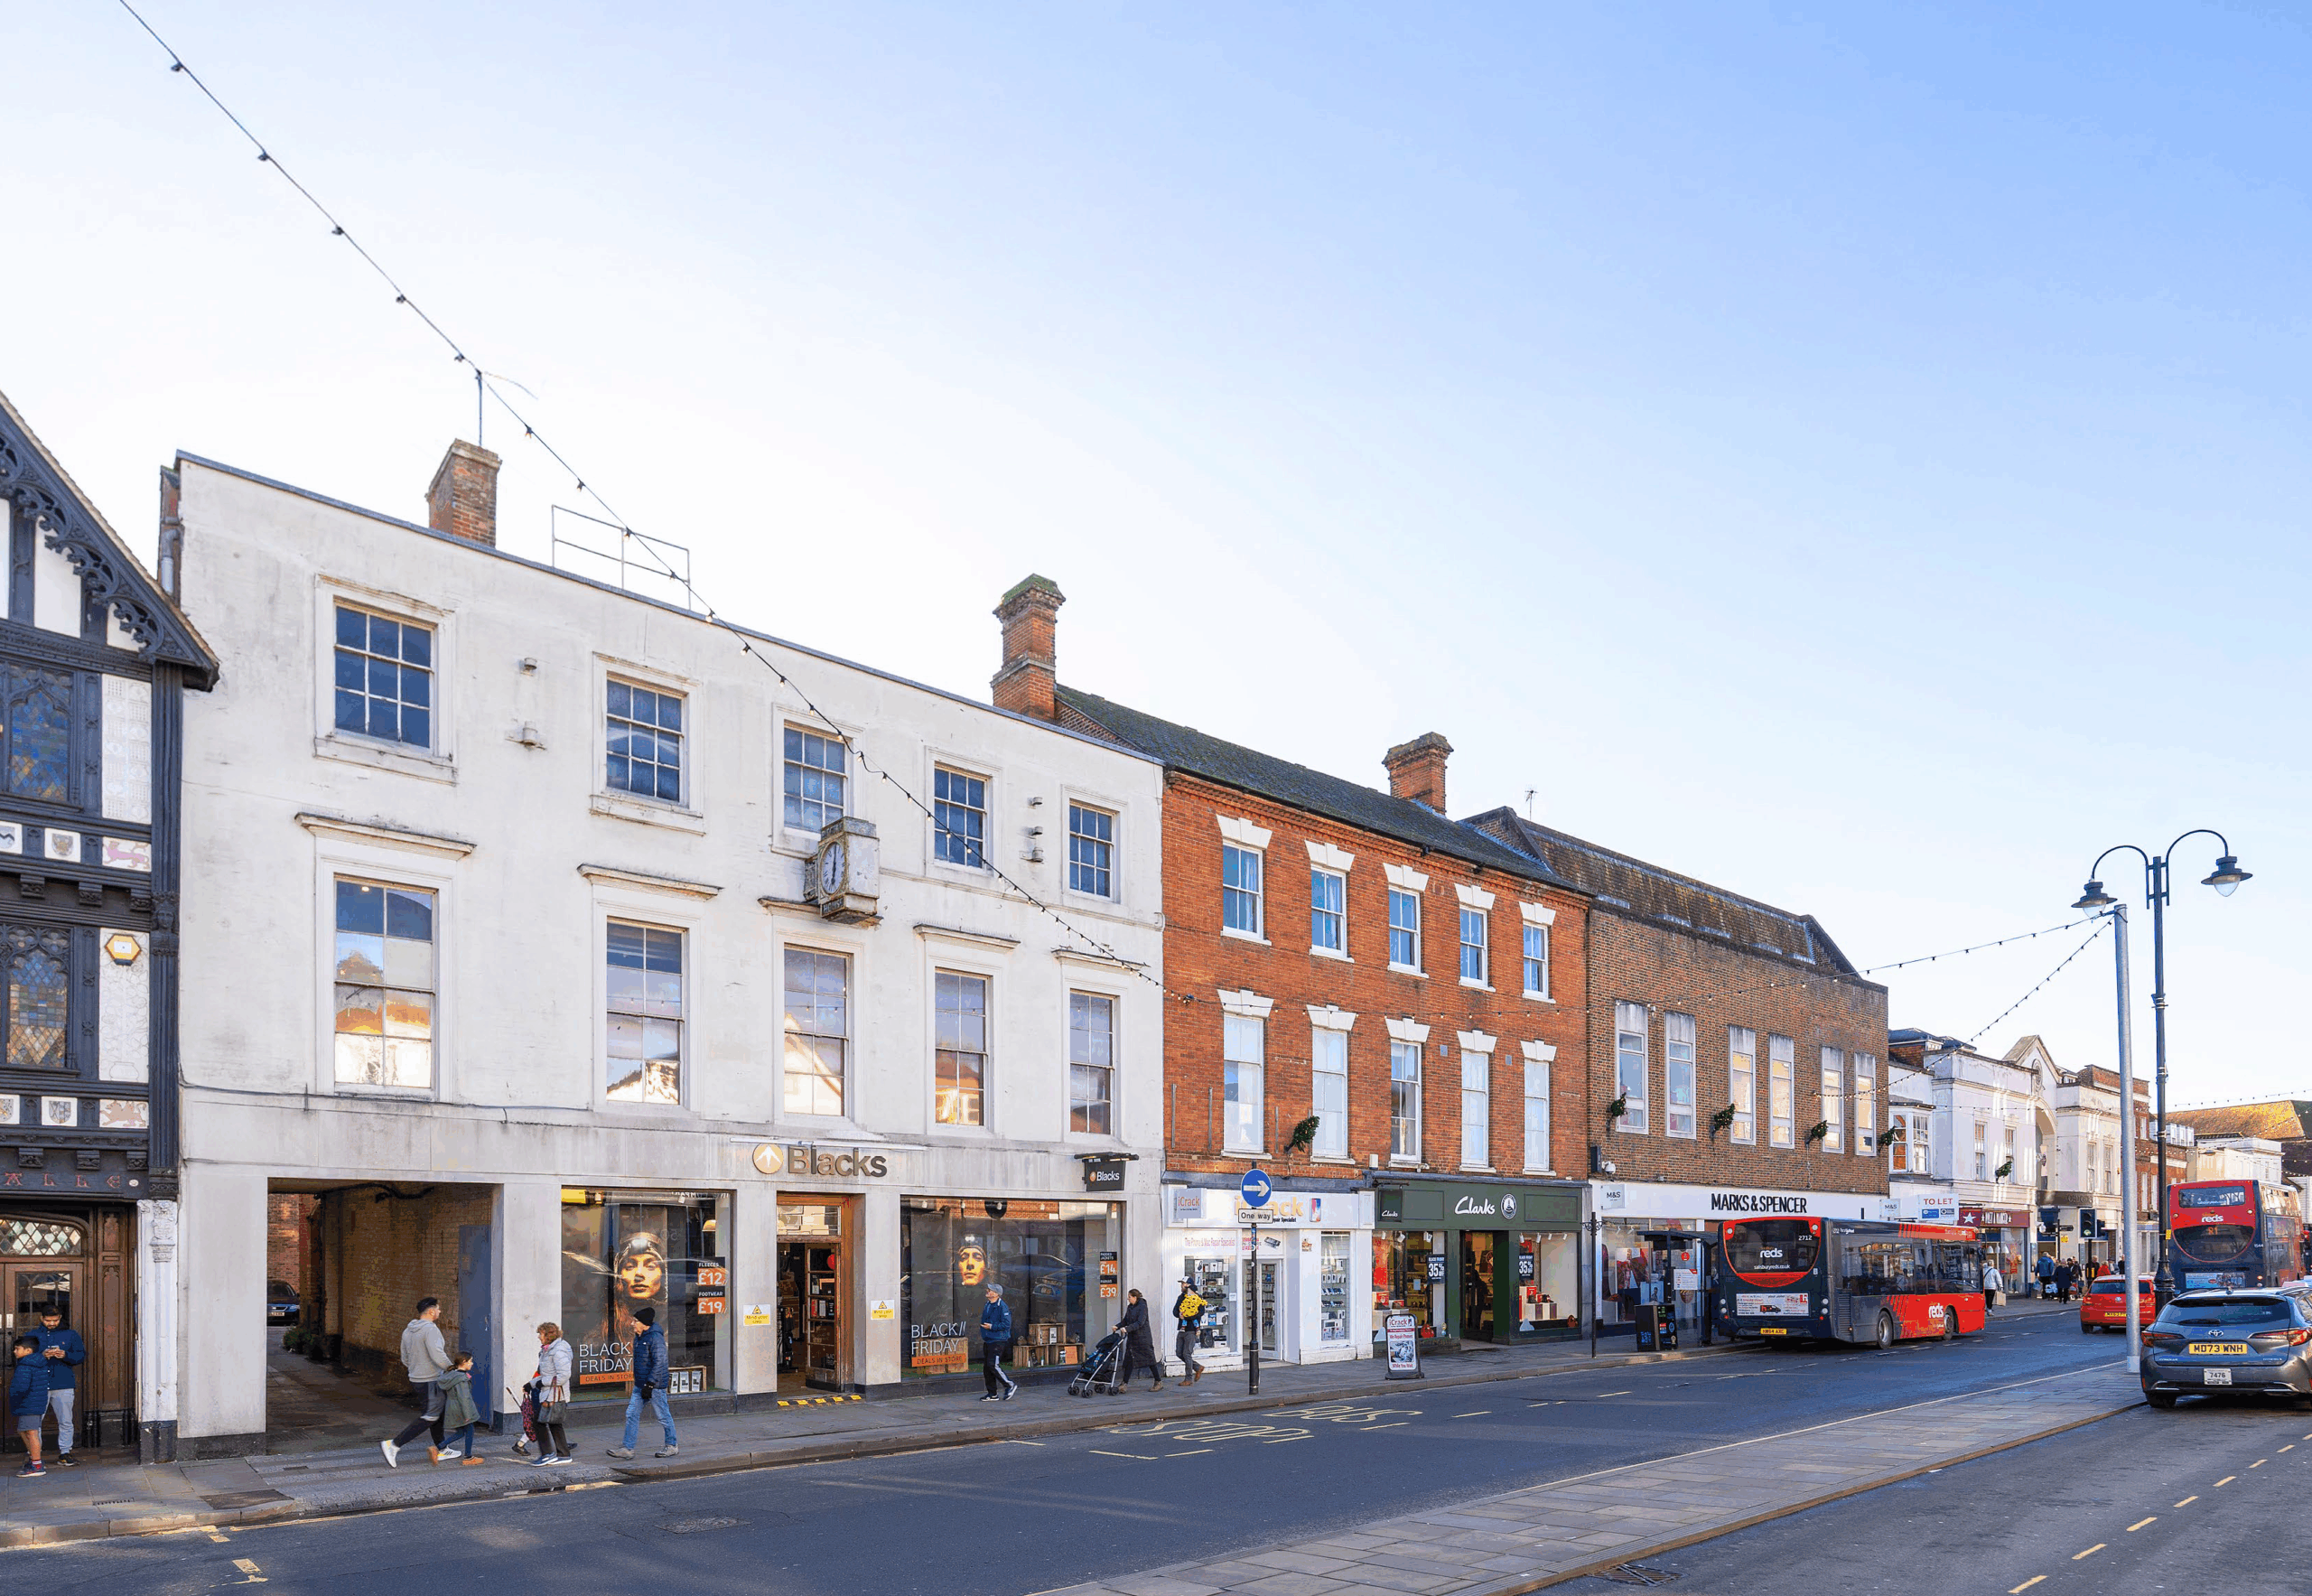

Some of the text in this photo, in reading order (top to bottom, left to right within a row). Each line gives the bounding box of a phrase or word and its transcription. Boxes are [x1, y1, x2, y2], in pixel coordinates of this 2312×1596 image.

[788, 1144, 888, 1177] Blacks
[1096, 1171, 1120, 1181] Blacks
[1178, 1196, 1200, 1207] iCrack
[1235, 1195, 1304, 1217] iack
[1455, 1196, 1496, 1215] Clarks
[1711, 1193, 1807, 1213] MARKS & SPENCER
[2202, 1214, 2223, 1223] reds
[1759, 1248, 1784, 1258] reds
[1101, 1265, 1115, 1274] £14
[1101, 1287, 1116, 1297] £39
[1928, 1302, 1944, 1318] reds
[579, 1341, 631, 1358] BLACK
[911, 1339, 960, 1355] FRIDAY
[2194, 1344, 2243, 1353] MD73 WNH
[579, 1358, 633, 1373] FRIDAY
